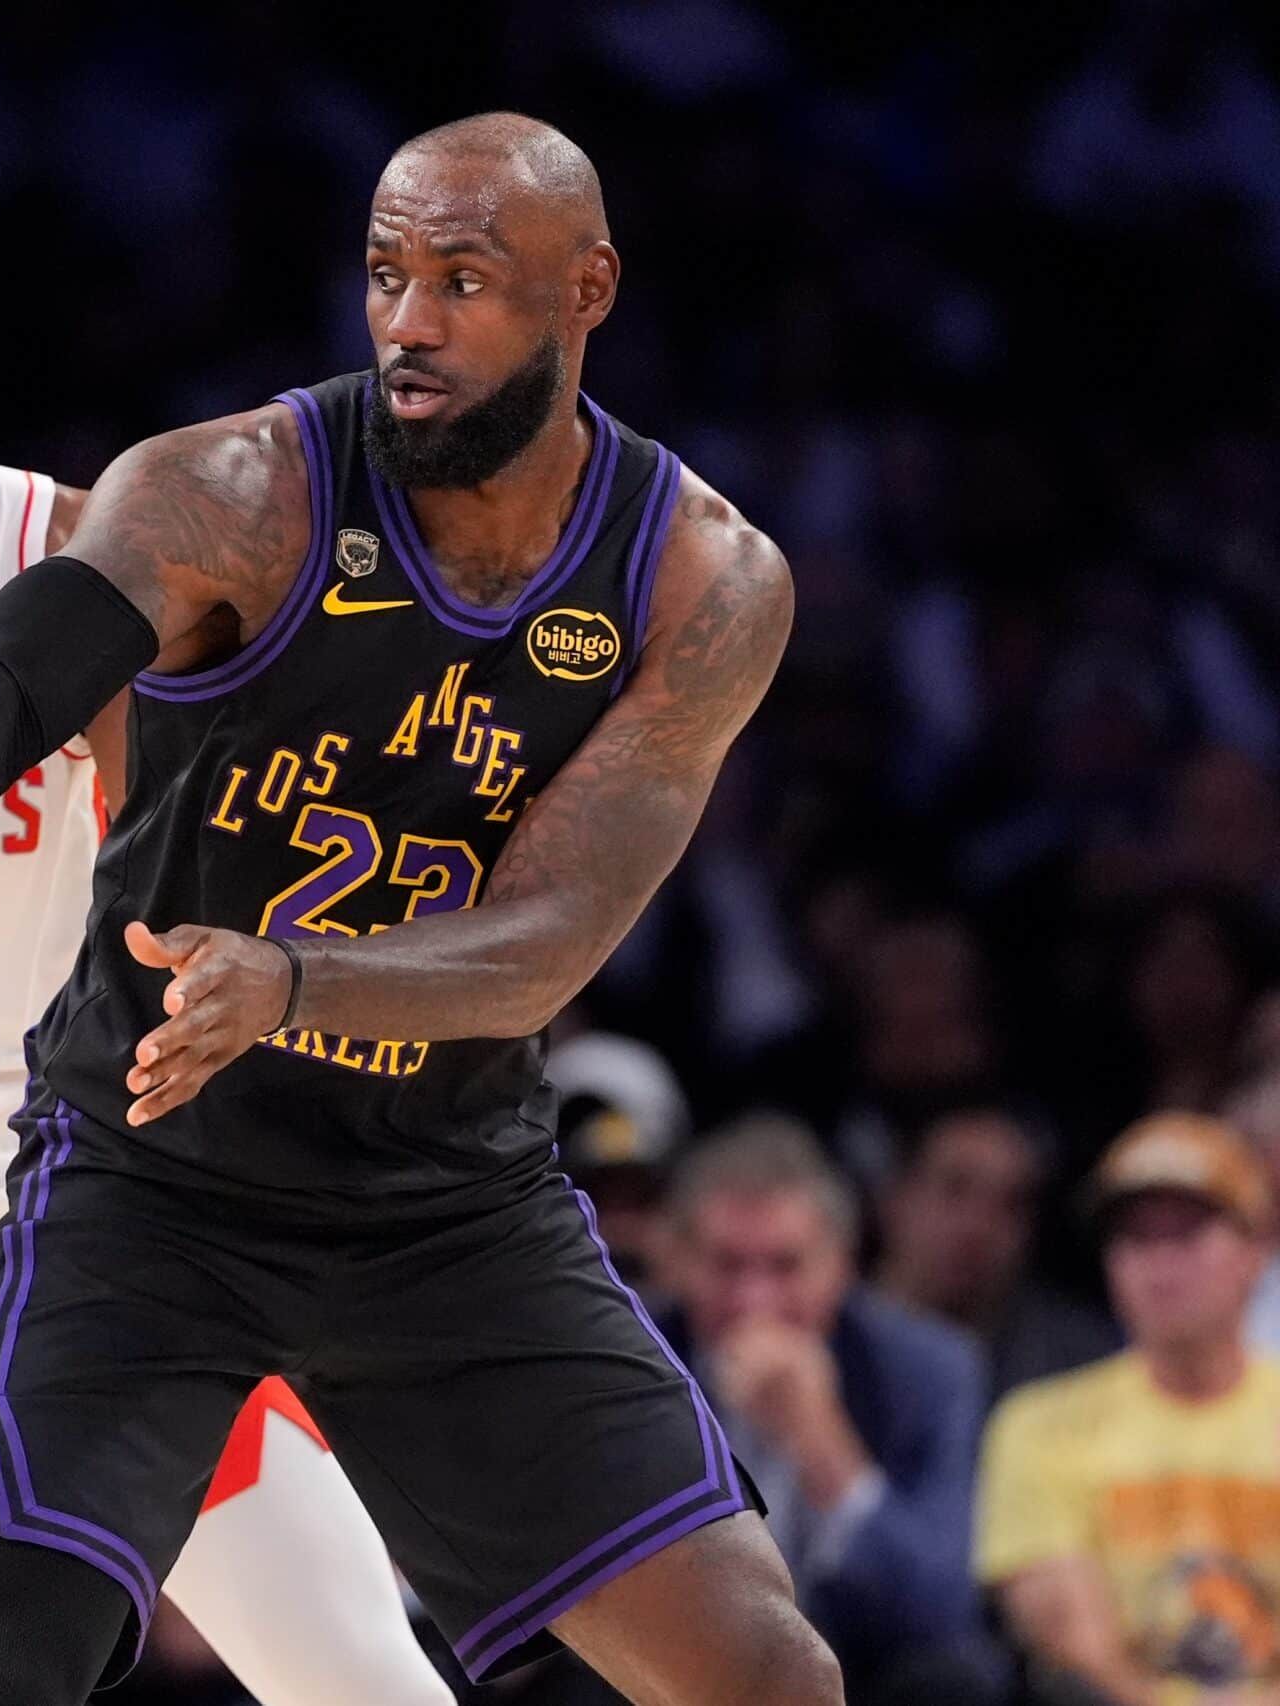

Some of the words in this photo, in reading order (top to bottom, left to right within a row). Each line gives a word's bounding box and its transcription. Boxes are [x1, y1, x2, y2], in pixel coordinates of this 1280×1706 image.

[536, 625, 615, 662] bibigo
[209, 732, 351, 834] LOS
[382, 662, 532, 822] ANGEL
[257, 802, 484, 938] 23
